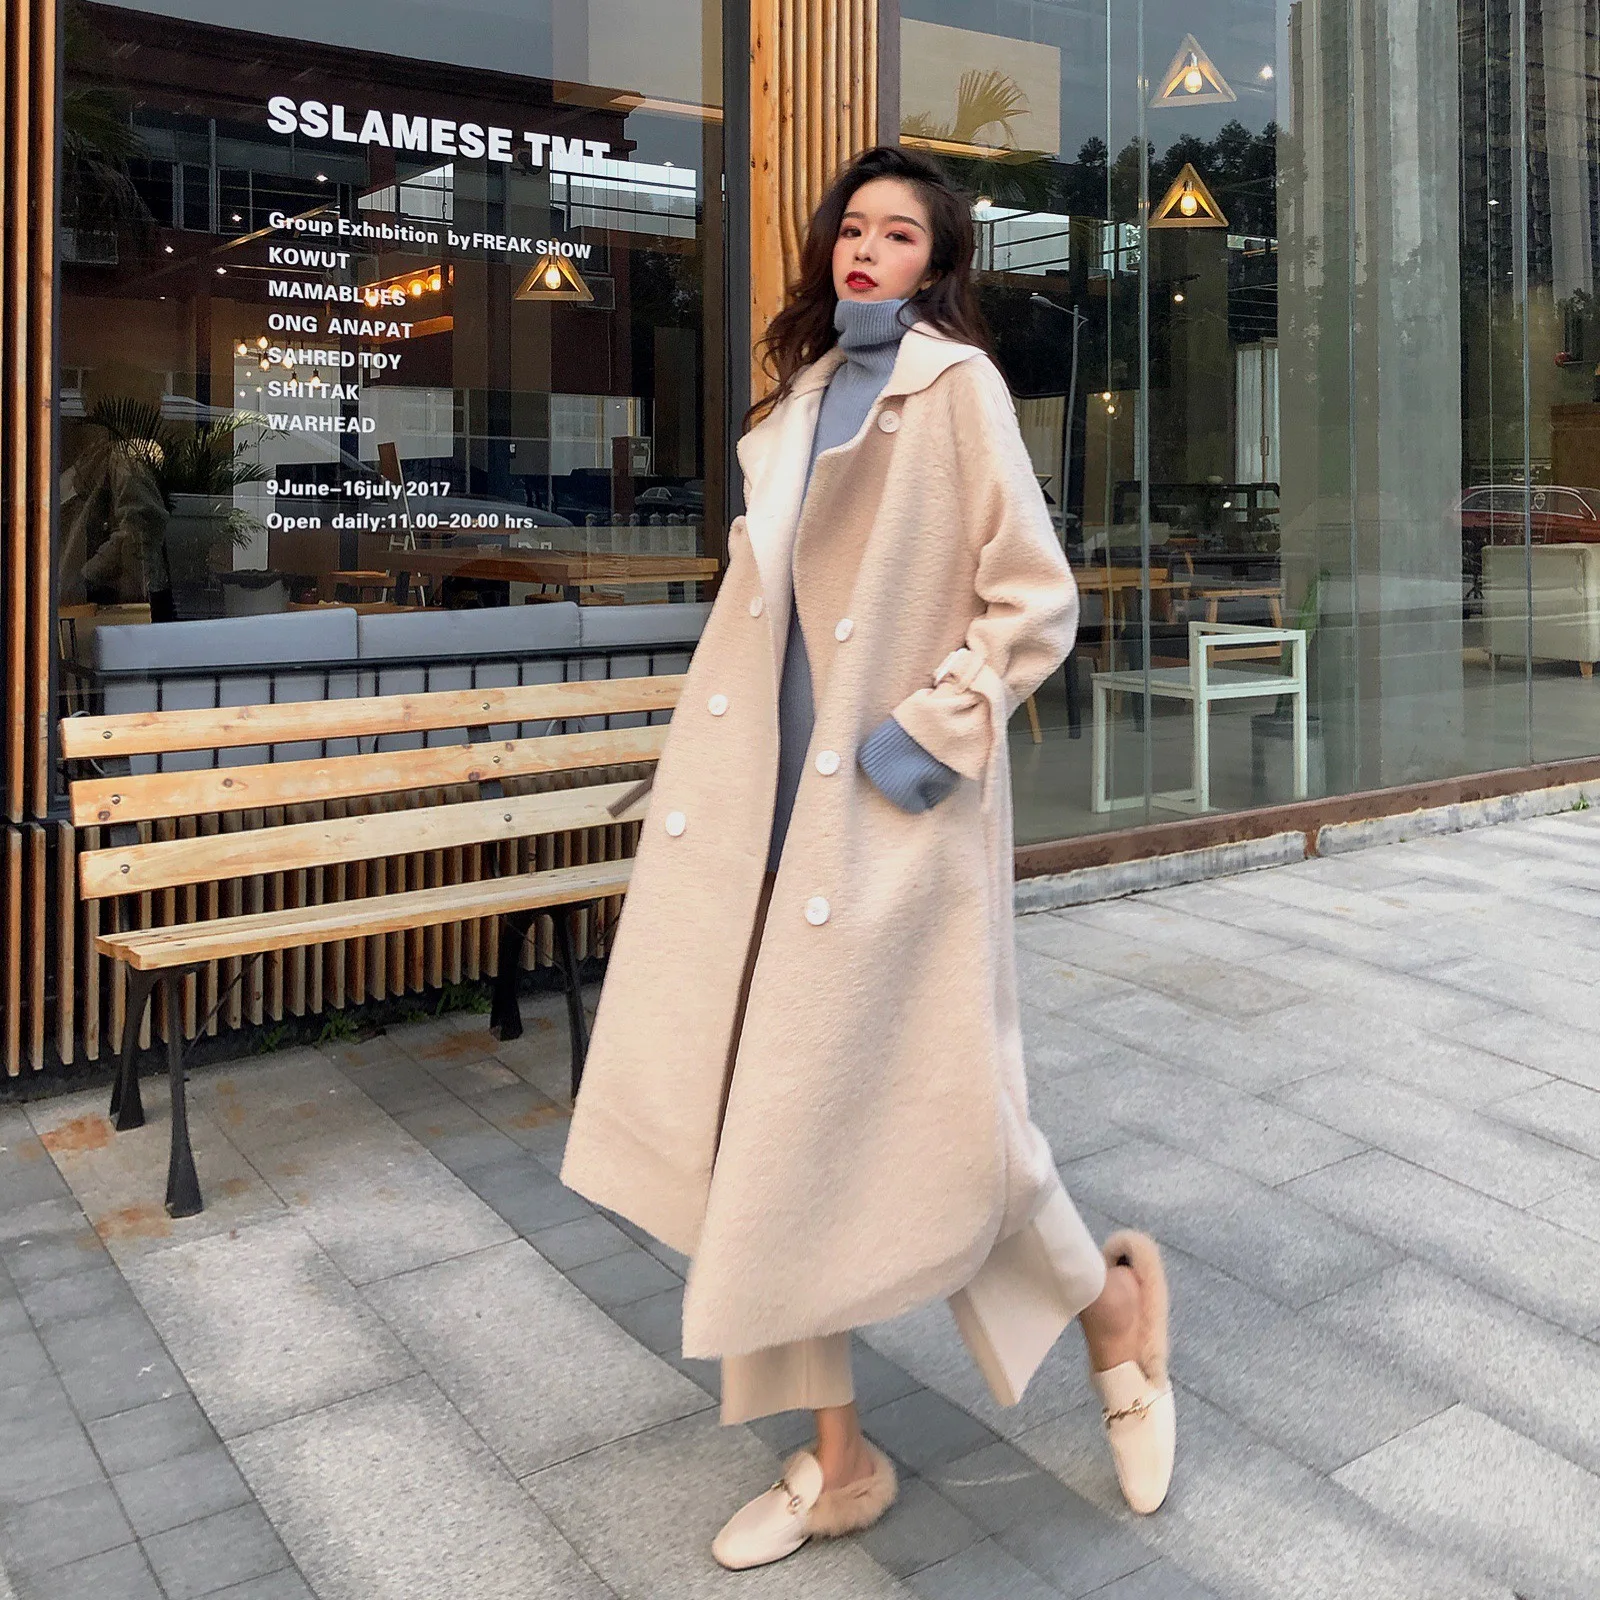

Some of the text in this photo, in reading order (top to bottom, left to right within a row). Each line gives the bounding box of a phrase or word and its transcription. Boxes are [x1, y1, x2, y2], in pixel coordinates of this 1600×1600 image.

[267, 96, 610, 174] SSLAMESE TMT
[268, 211, 333, 236] Group
[447, 229, 471, 250] by
[472, 232, 533, 254] FREAK
[535, 239, 591, 259] SHOW
[268, 246, 350, 269] KOWUT
[268, 280, 406, 306] MAMABLUES
[268, 313, 414, 339] ONG ANAPAT
[267, 346, 402, 370] SAHRED TOY
[267, 380, 360, 400] SHITTAK
[267, 413, 376, 433] WARHEAD
[405, 480, 451, 496] 2017
[266, 513, 321, 532] Open
[504, 513, 539, 529] hrs.
